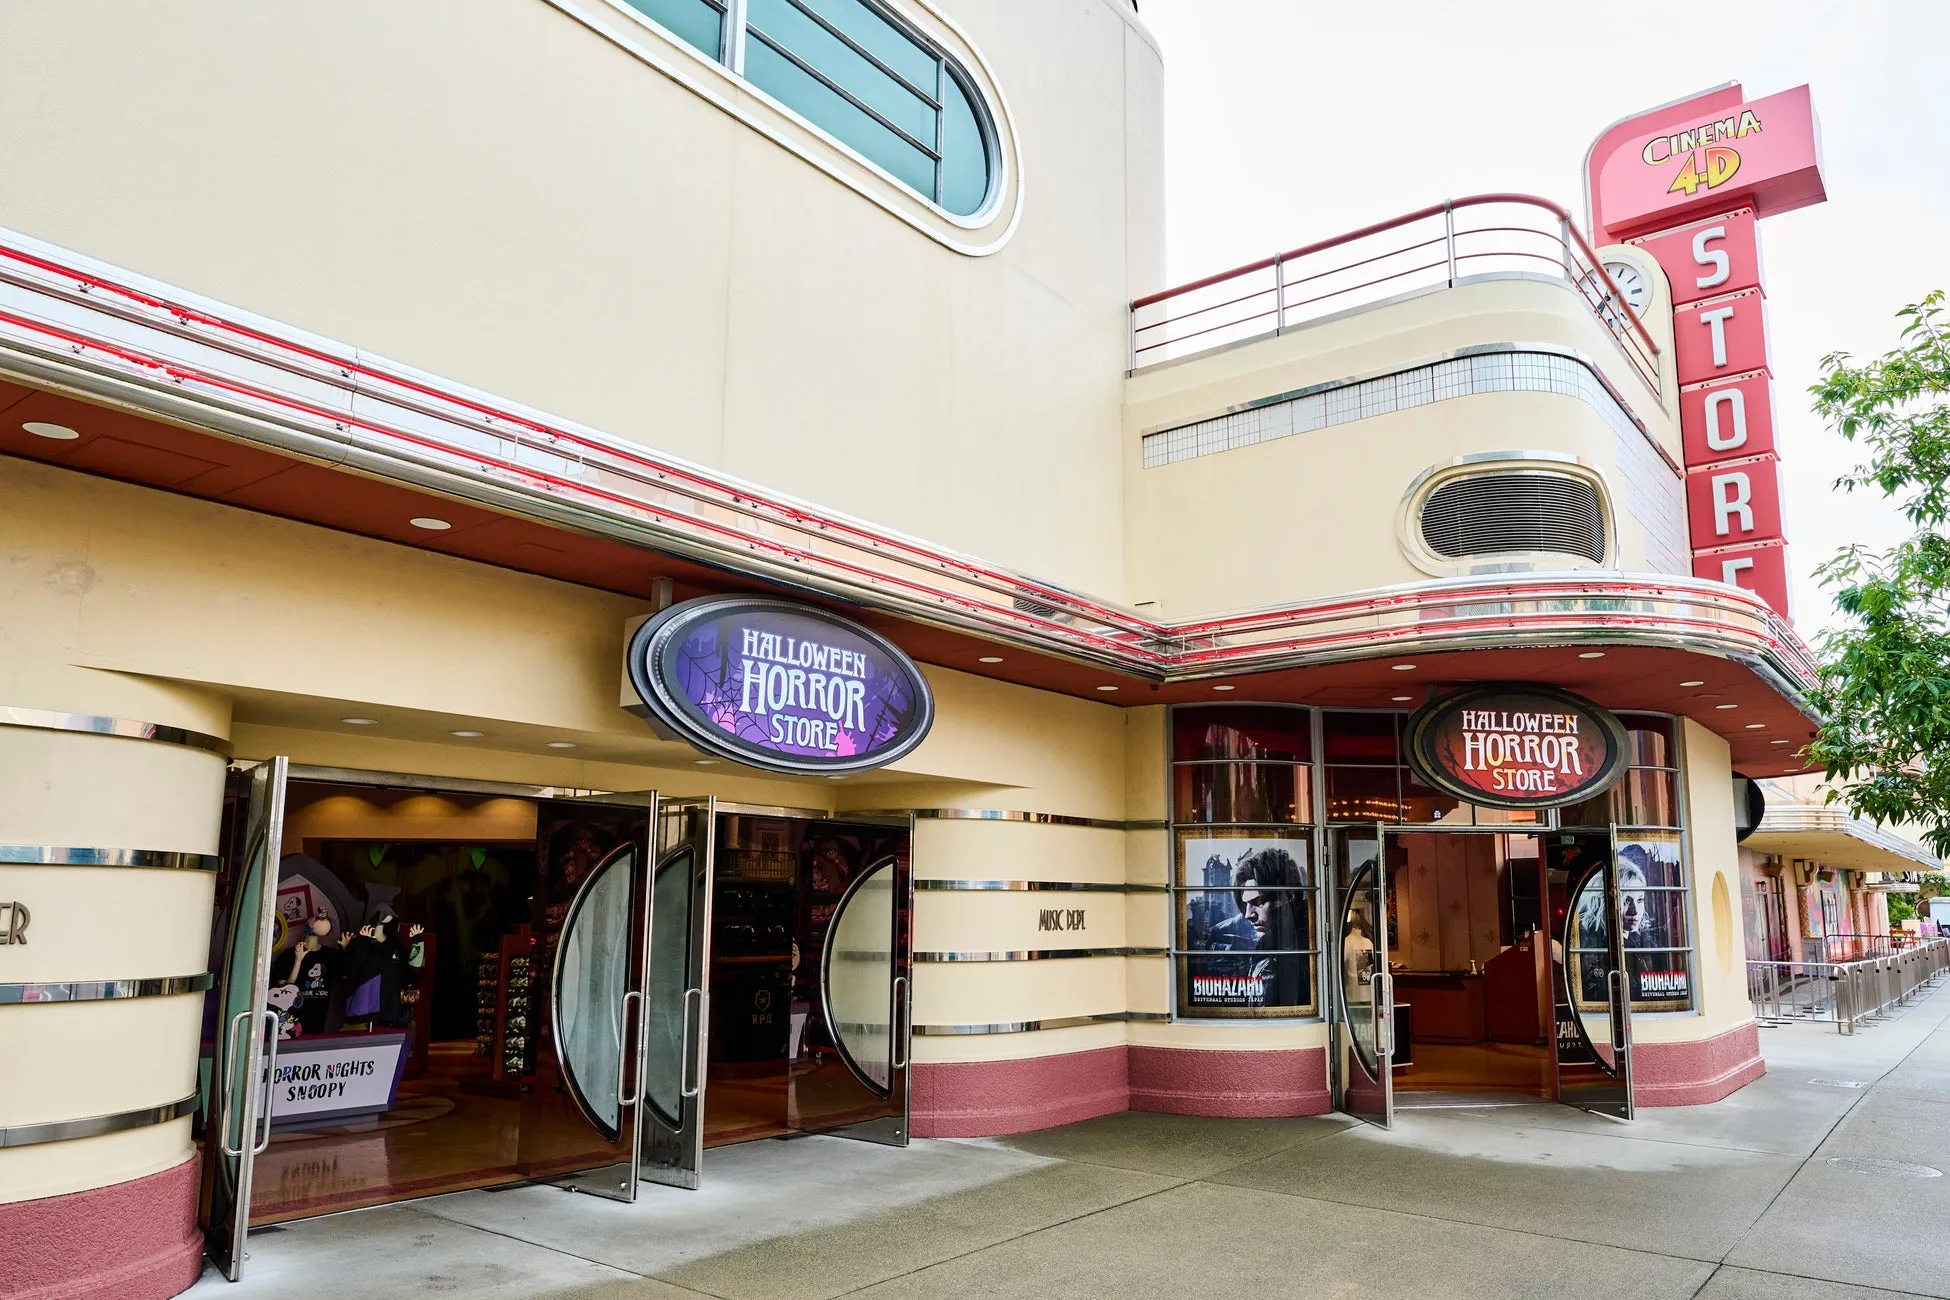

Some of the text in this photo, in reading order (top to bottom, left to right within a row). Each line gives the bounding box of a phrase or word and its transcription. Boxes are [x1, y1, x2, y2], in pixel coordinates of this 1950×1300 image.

[1642, 109, 1762, 166] CINEMA
[742, 628, 866, 679] HALLOWEEN
[739, 659, 867, 732] HORROR
[770, 713, 839, 751] STORE
[1461, 710, 1579, 735] HALLOWEEN
[1463, 732, 1584, 776] HORROR
[1492, 768, 1557, 792] STORE
[1039, 909, 1064, 931] MUSIC
[1193, 975, 1264, 997] BIOHAZARD
[286, 1081, 347, 1102] SNOOPY
